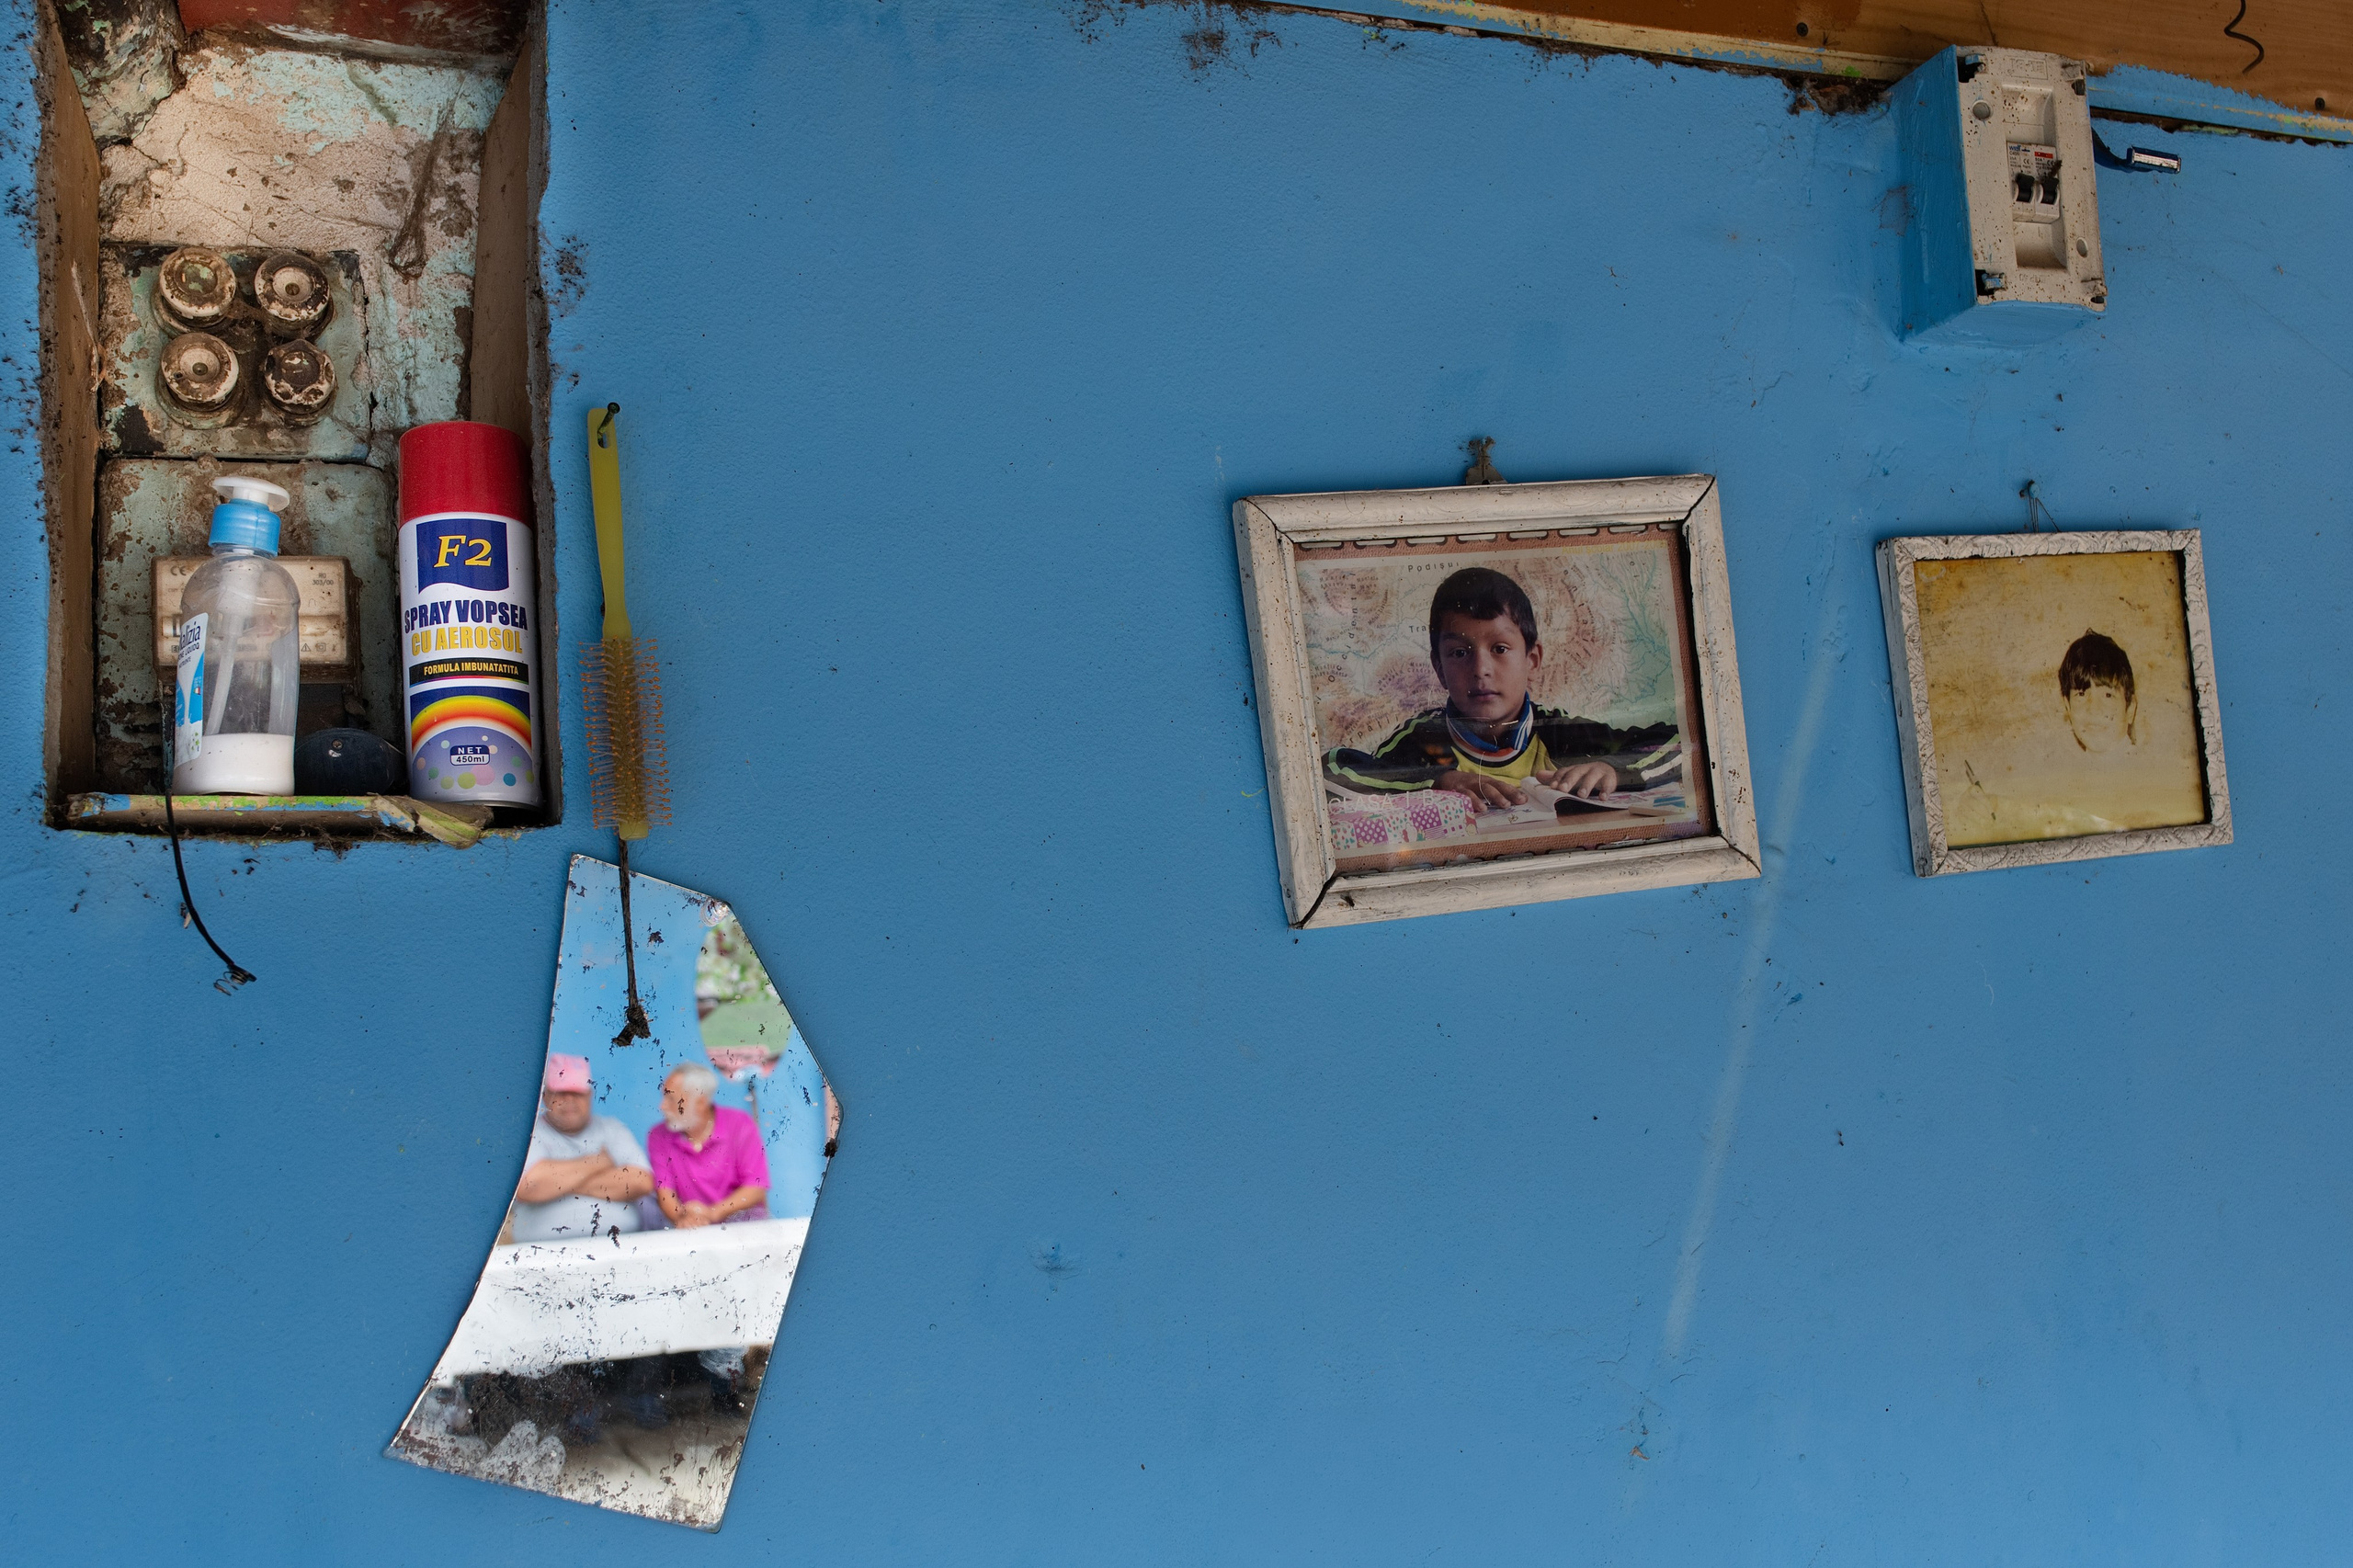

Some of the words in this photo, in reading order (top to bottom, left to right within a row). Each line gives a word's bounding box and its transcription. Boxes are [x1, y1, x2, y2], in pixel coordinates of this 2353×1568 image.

[434, 535, 492, 567] F2
[404, 600, 451, 634] SPRAY
[455, 599, 529, 631] VOPSEA
[180, 620, 201, 650] alizia
[411, 629, 431, 656] CU
[435, 626, 523, 654] AEROSOL
[424, 663, 460, 676] FORMULA
[461, 662, 519, 676] IMBUNATATITA
[456, 756, 484, 764] 450ml
[458, 746, 483, 755] NET
